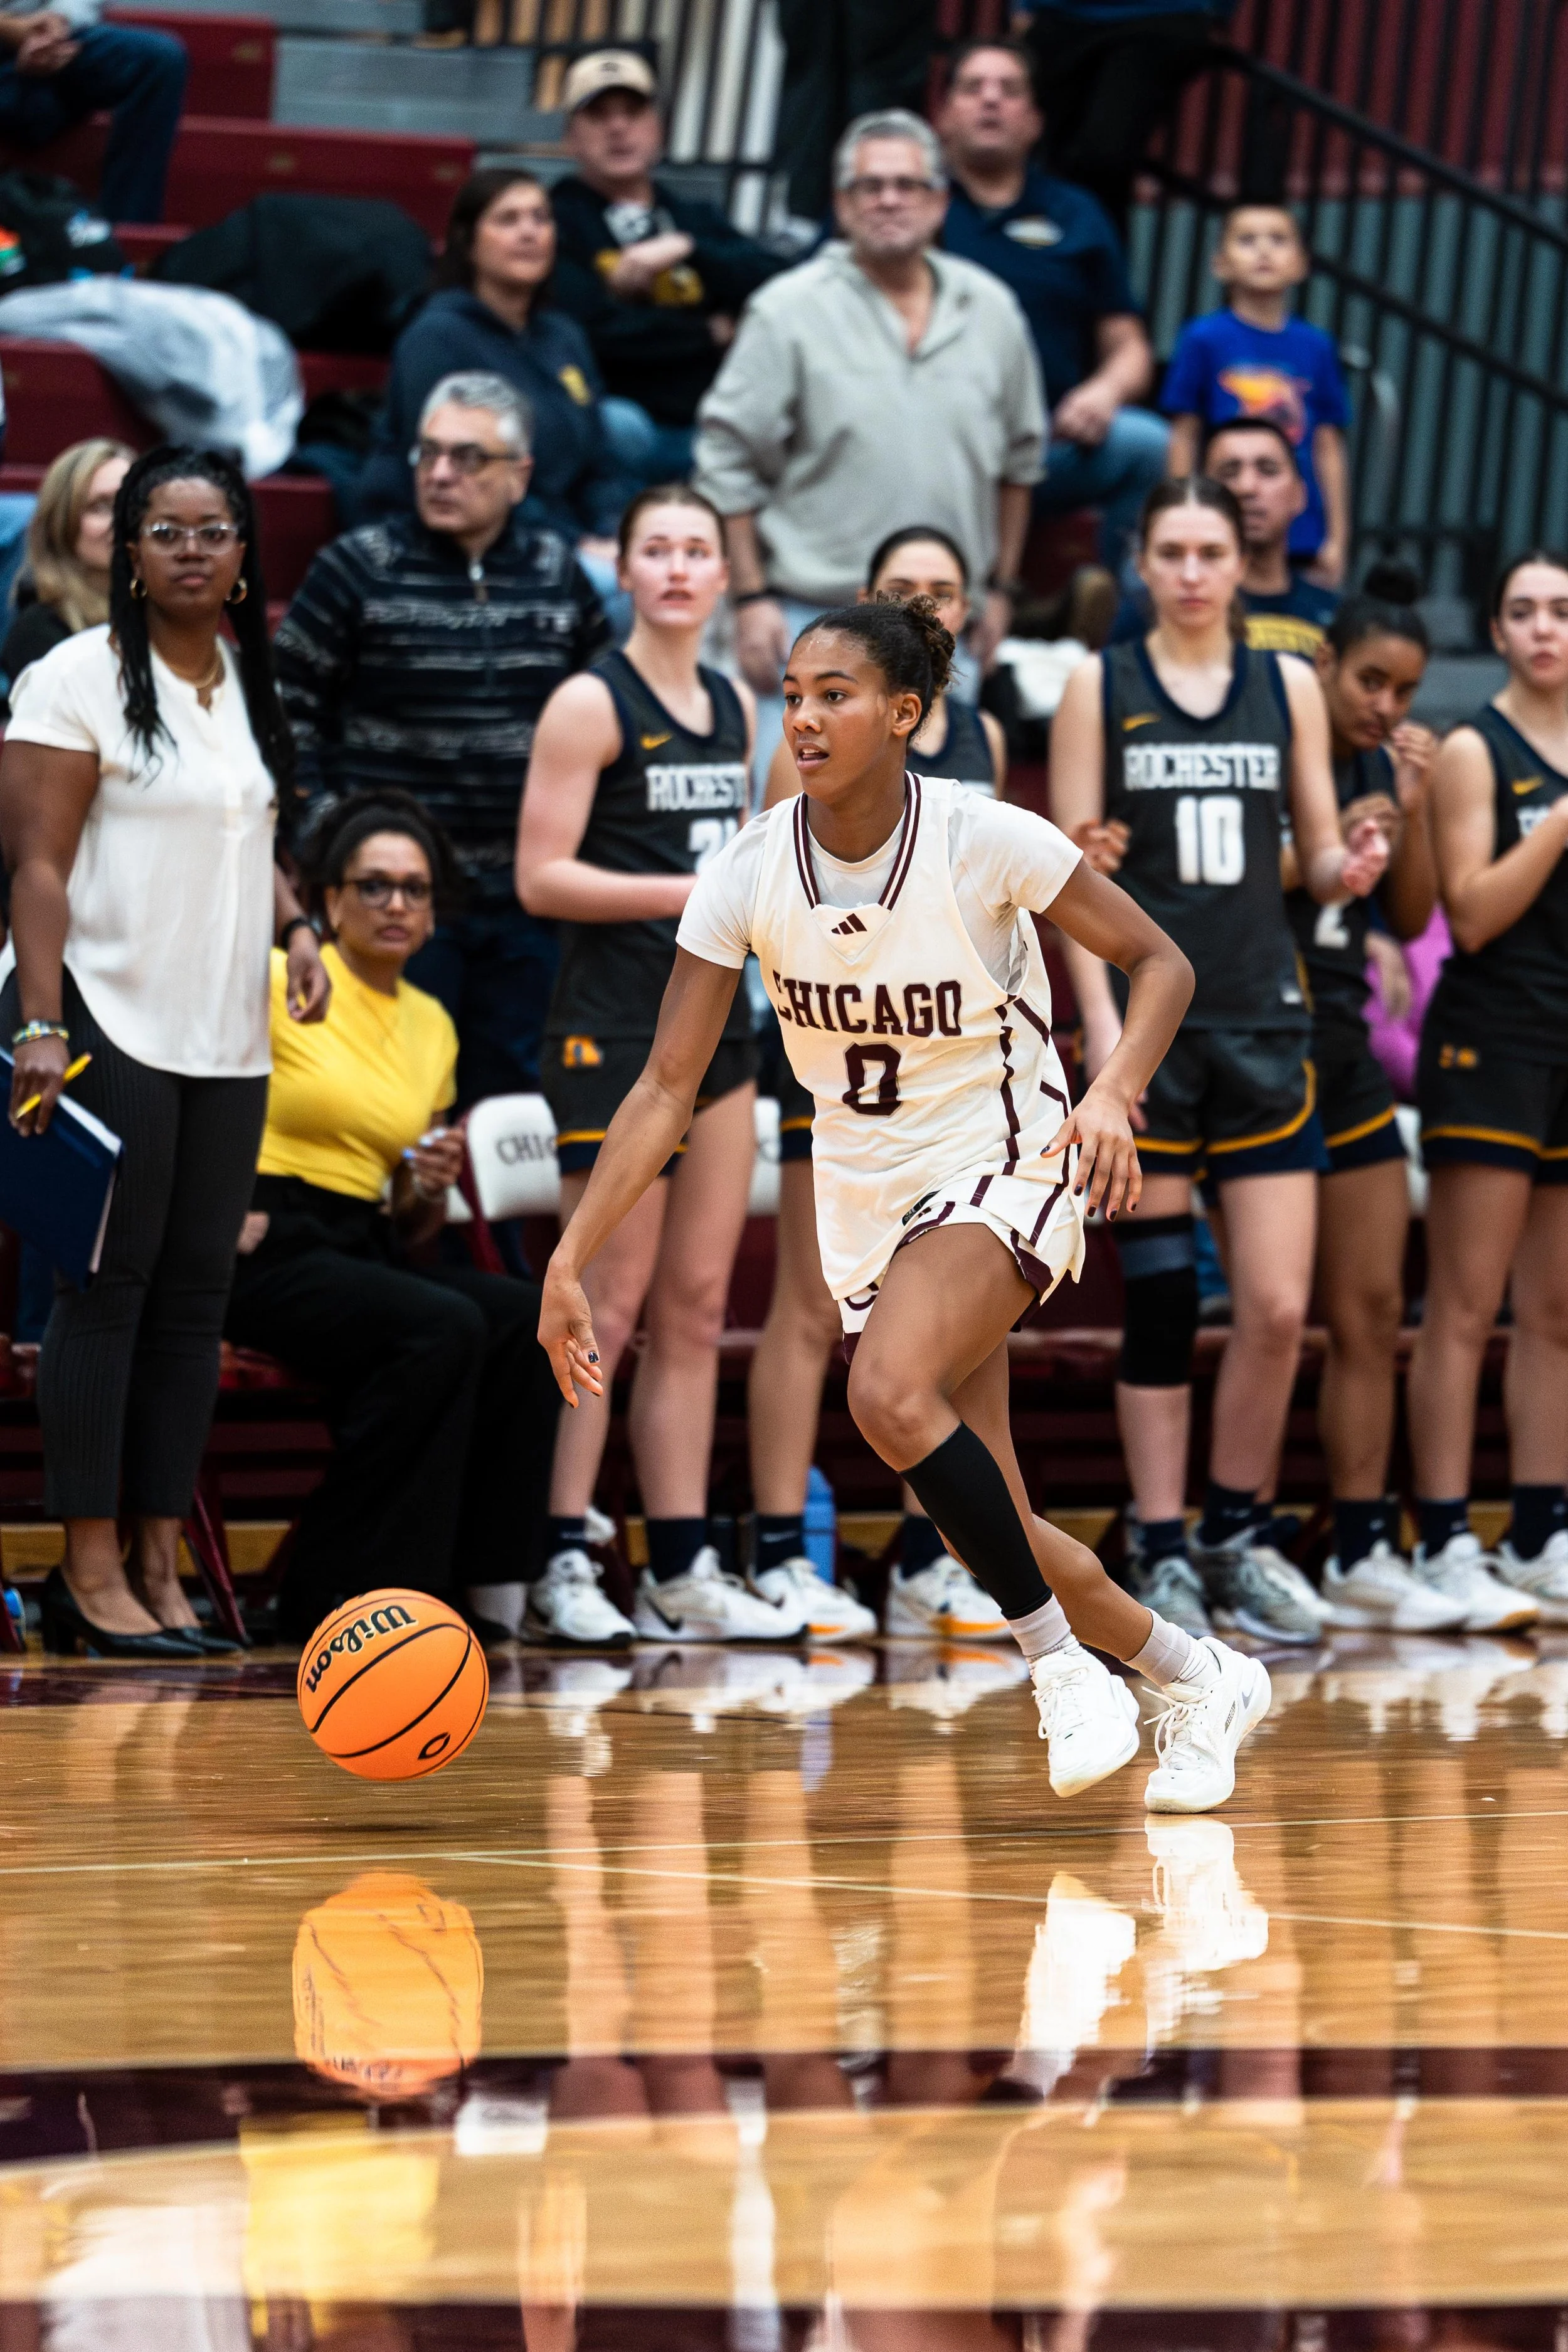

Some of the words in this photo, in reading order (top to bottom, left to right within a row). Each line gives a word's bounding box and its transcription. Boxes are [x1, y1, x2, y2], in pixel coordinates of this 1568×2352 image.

[1123, 743, 1281, 790] ROCHESTER
[1175, 795, 1244, 885] 10
[842, 1042, 902, 1116] 0
[305, 1605, 416, 1693] Wilson
